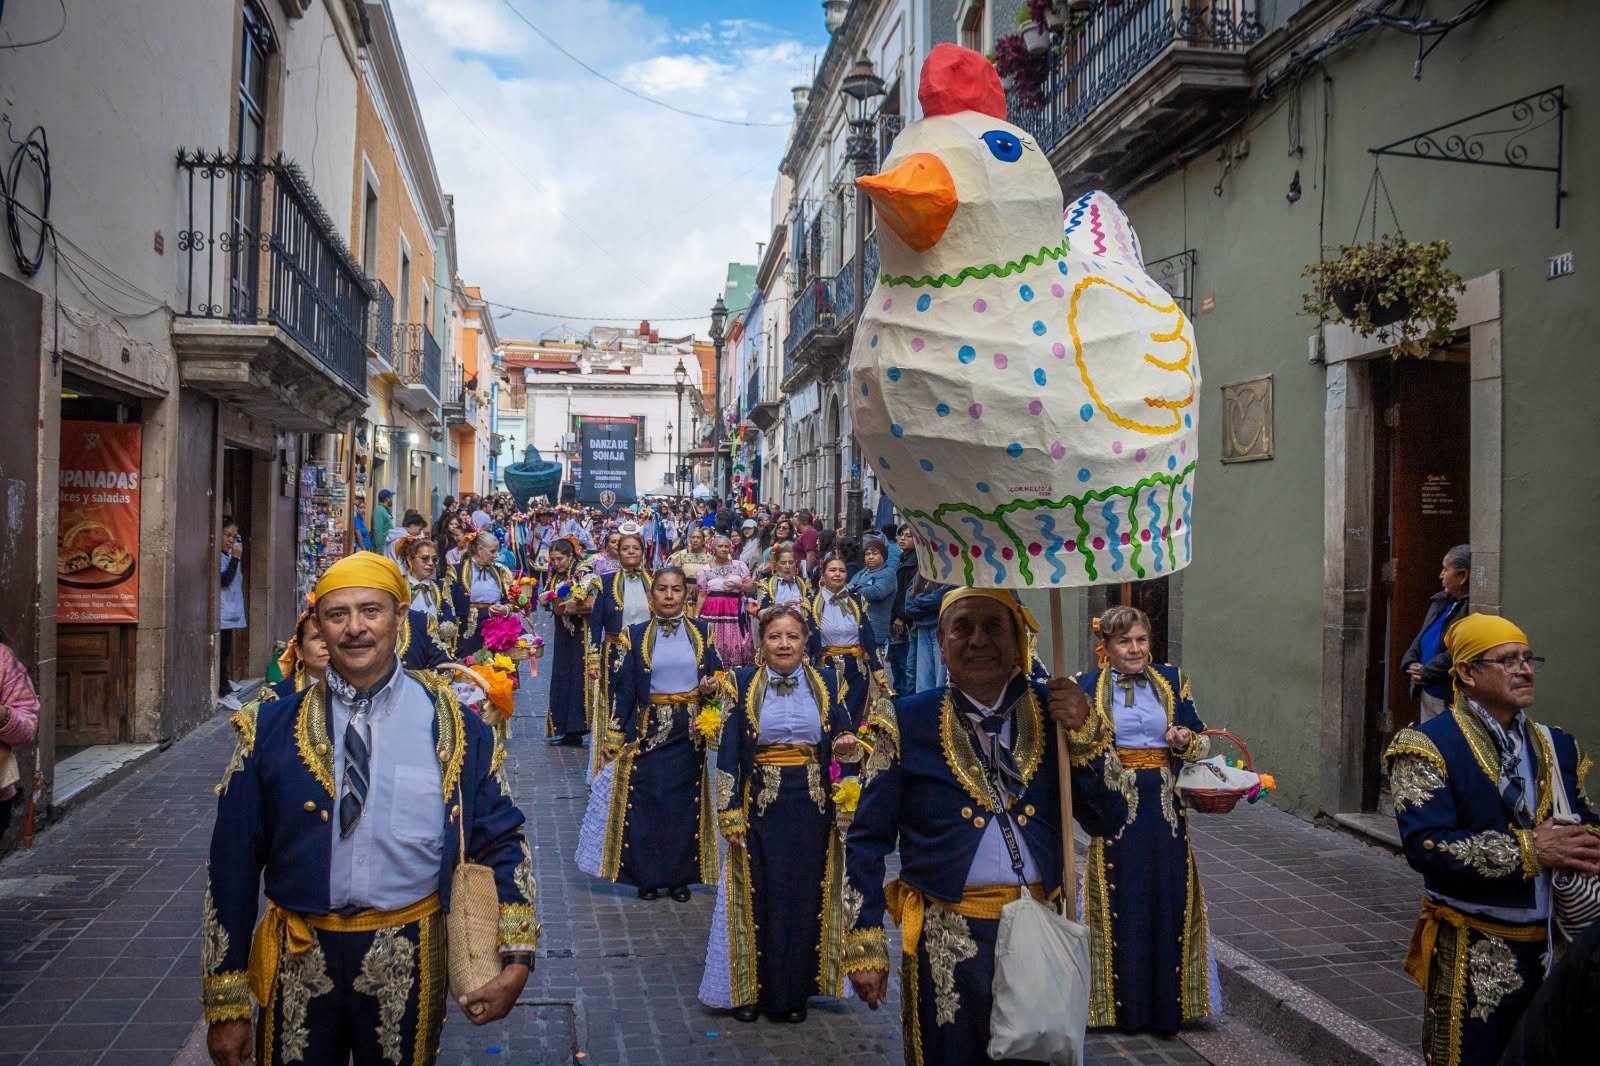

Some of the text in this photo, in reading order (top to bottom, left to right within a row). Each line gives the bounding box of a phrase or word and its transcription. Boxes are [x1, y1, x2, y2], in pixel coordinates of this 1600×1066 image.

[1550, 255, 1572, 277] 118
[590, 439, 629, 449] DANZA DE
[592, 451, 625, 461] SONAJA
[83, 494, 90, 505] y
[91, 492, 130, 504] saladas
[1002, 826, 1020, 860] STREET
